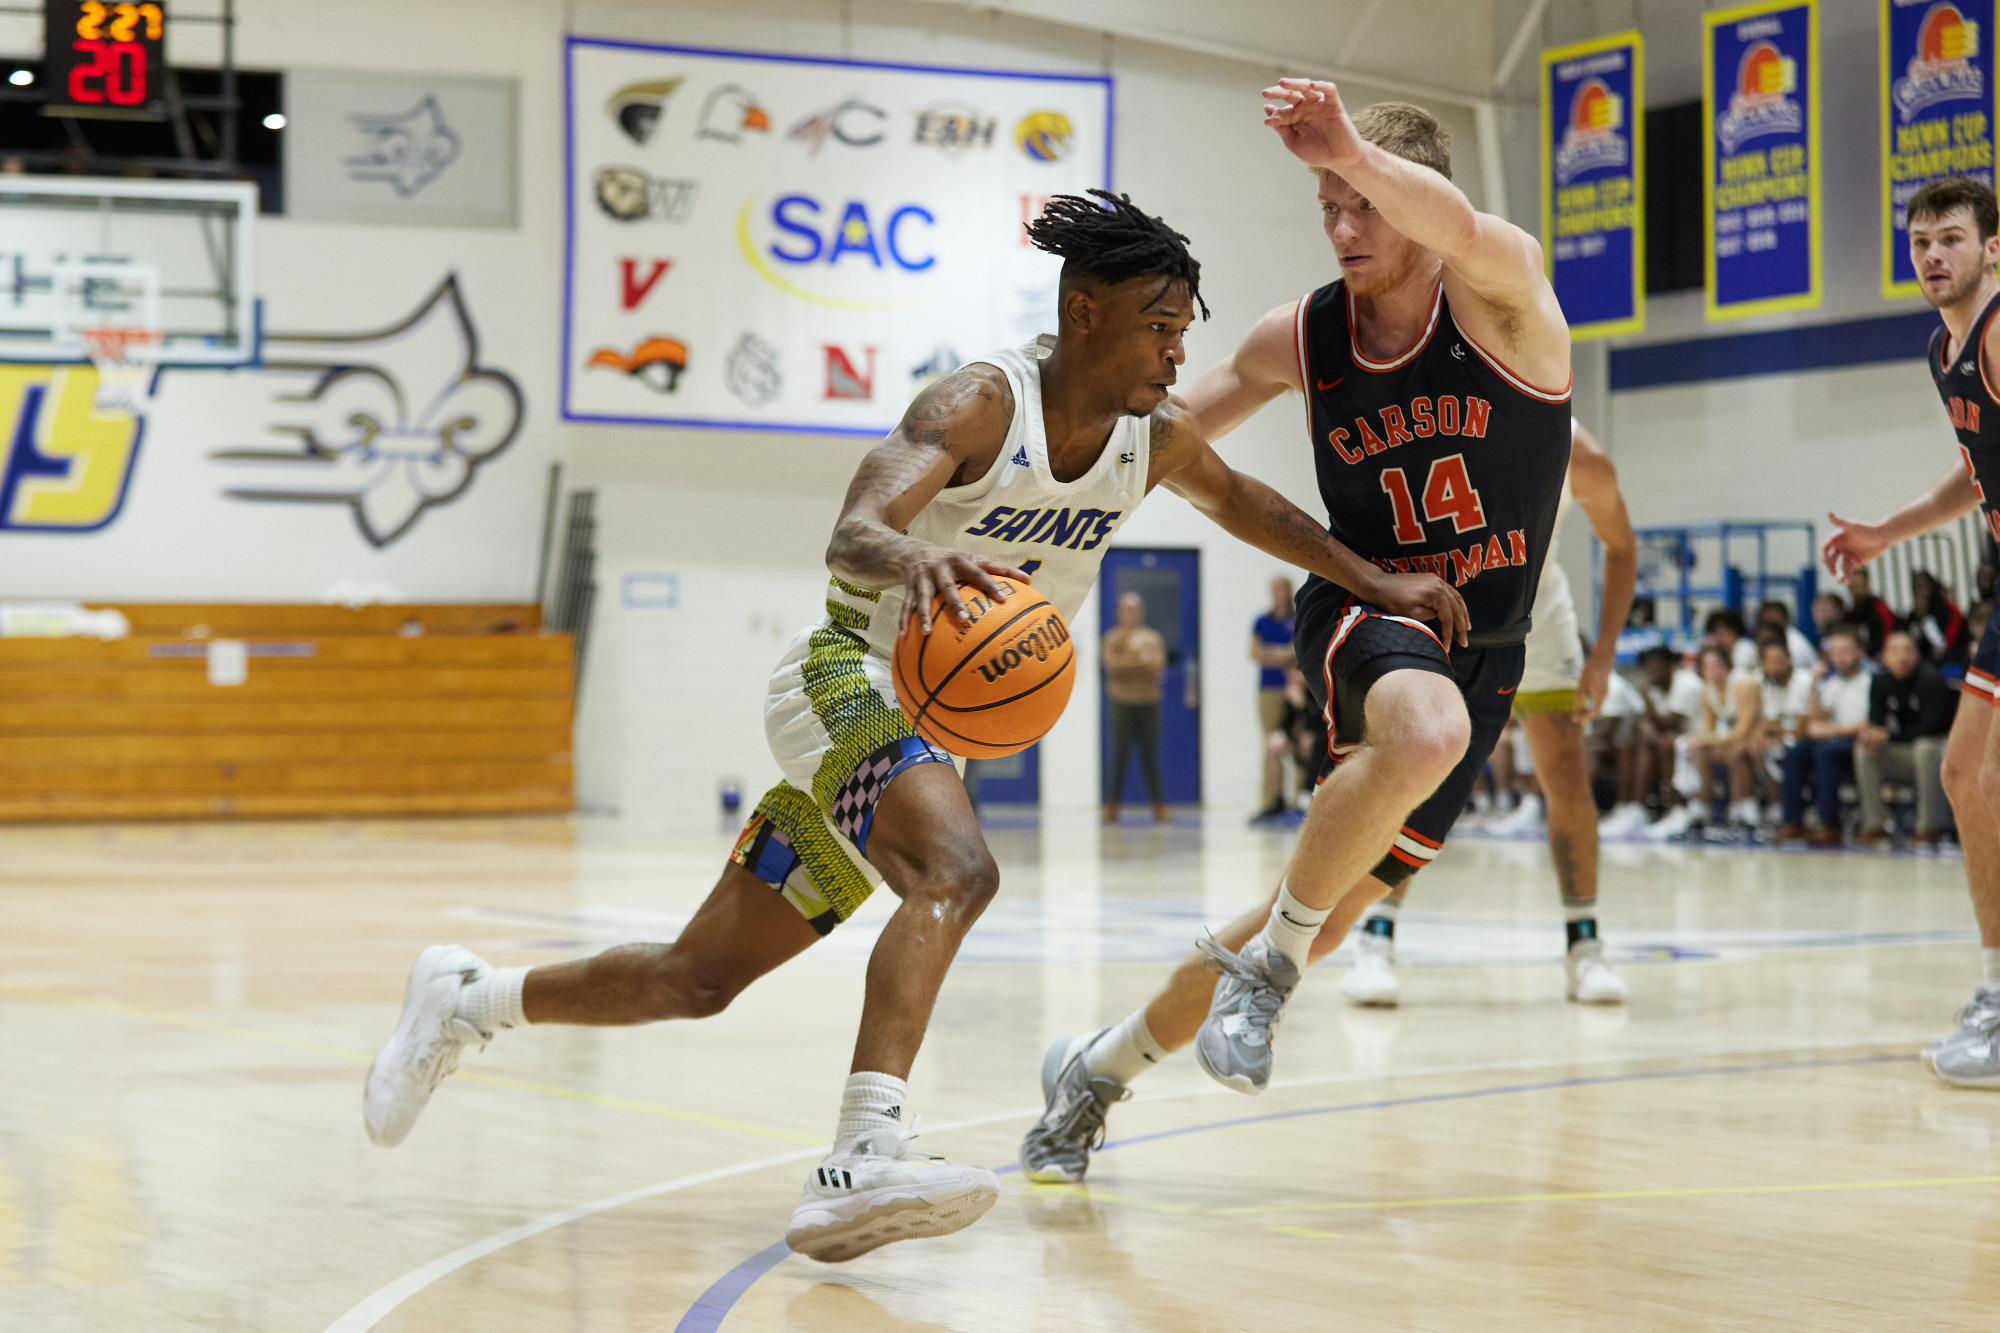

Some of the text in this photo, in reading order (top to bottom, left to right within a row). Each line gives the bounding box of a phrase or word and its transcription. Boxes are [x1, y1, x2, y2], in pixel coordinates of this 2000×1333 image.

[67, 38, 148, 106] 20
[768, 195, 937, 272] SAC
[618, 257, 672, 313] V
[822, 344, 877, 402] N
[1329, 395, 1491, 465] CARSON
[964, 505, 1123, 551] SAINTS
[1380, 453, 1487, 545] 14
[976, 613, 1070, 684] Wilson
